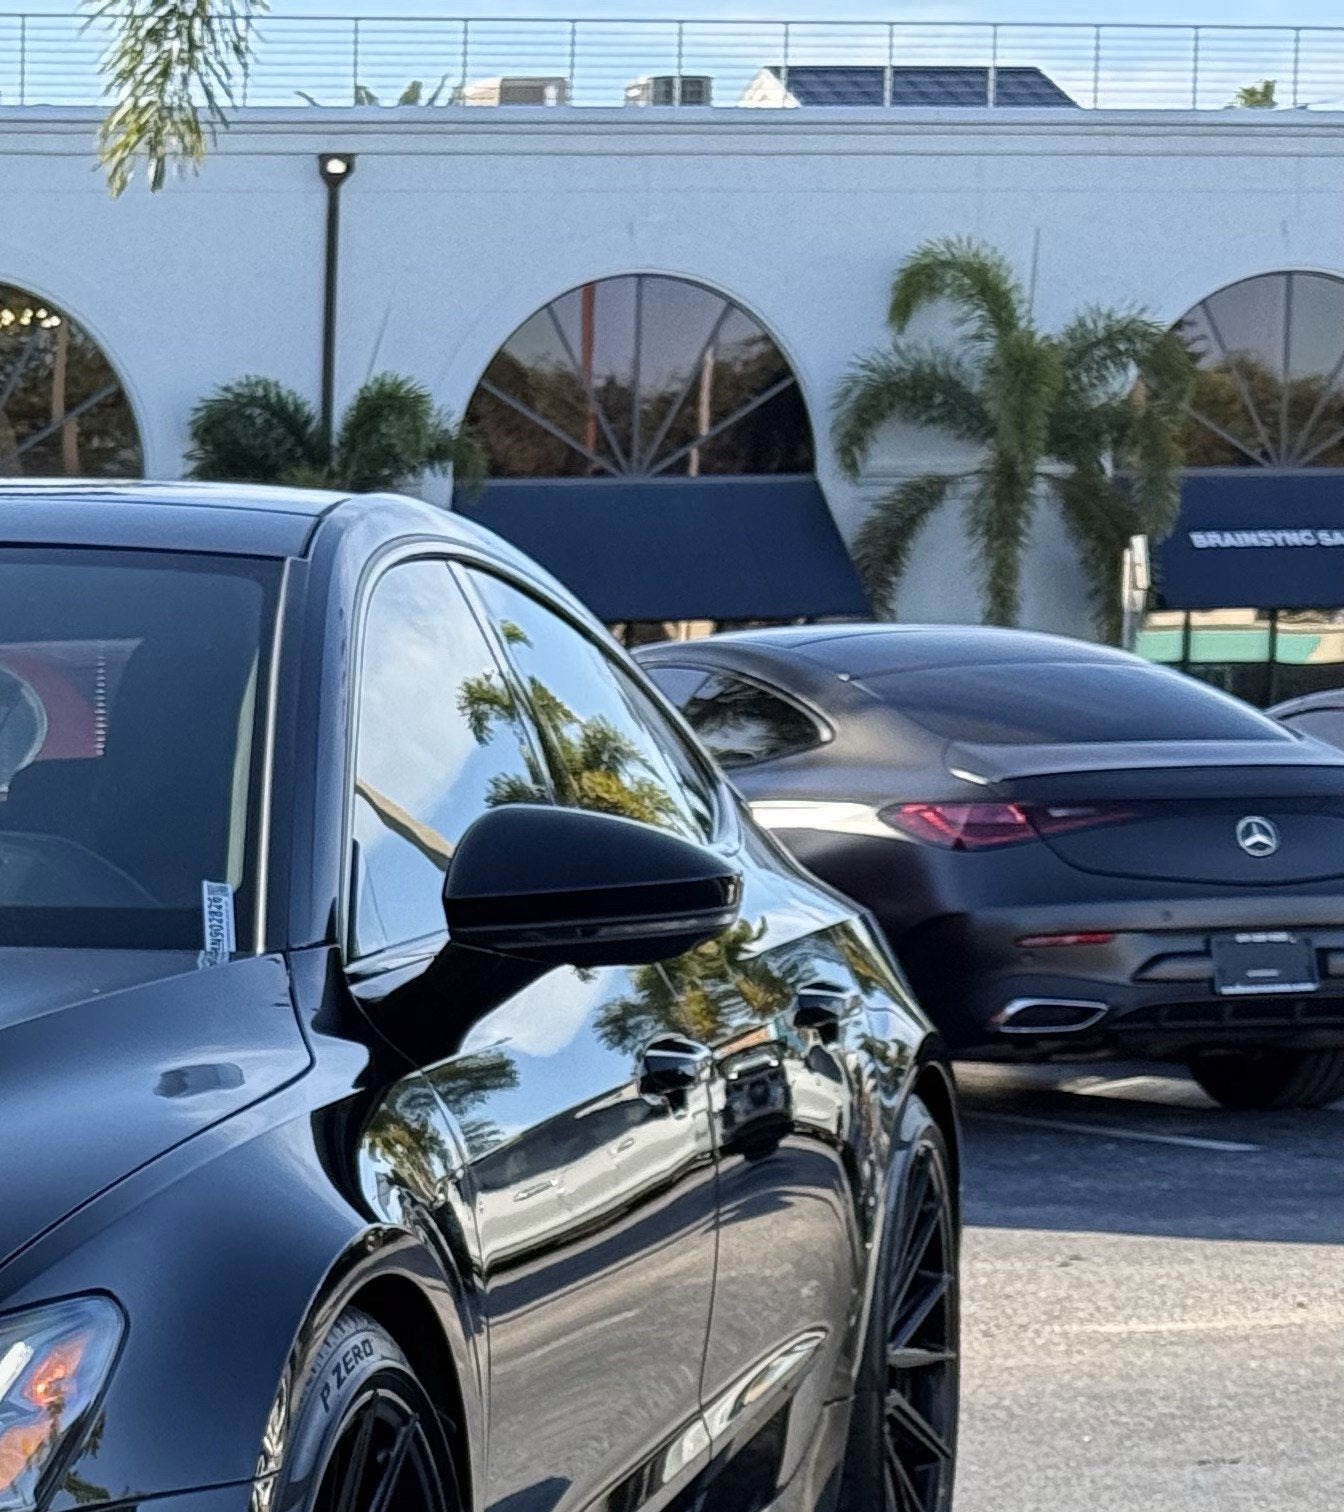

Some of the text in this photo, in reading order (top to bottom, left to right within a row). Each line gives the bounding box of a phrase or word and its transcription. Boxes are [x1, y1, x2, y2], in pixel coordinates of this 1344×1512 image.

[1189, 530, 1317, 549] BRAINSYNC
[320, 1338, 374, 1414] P ZERO
